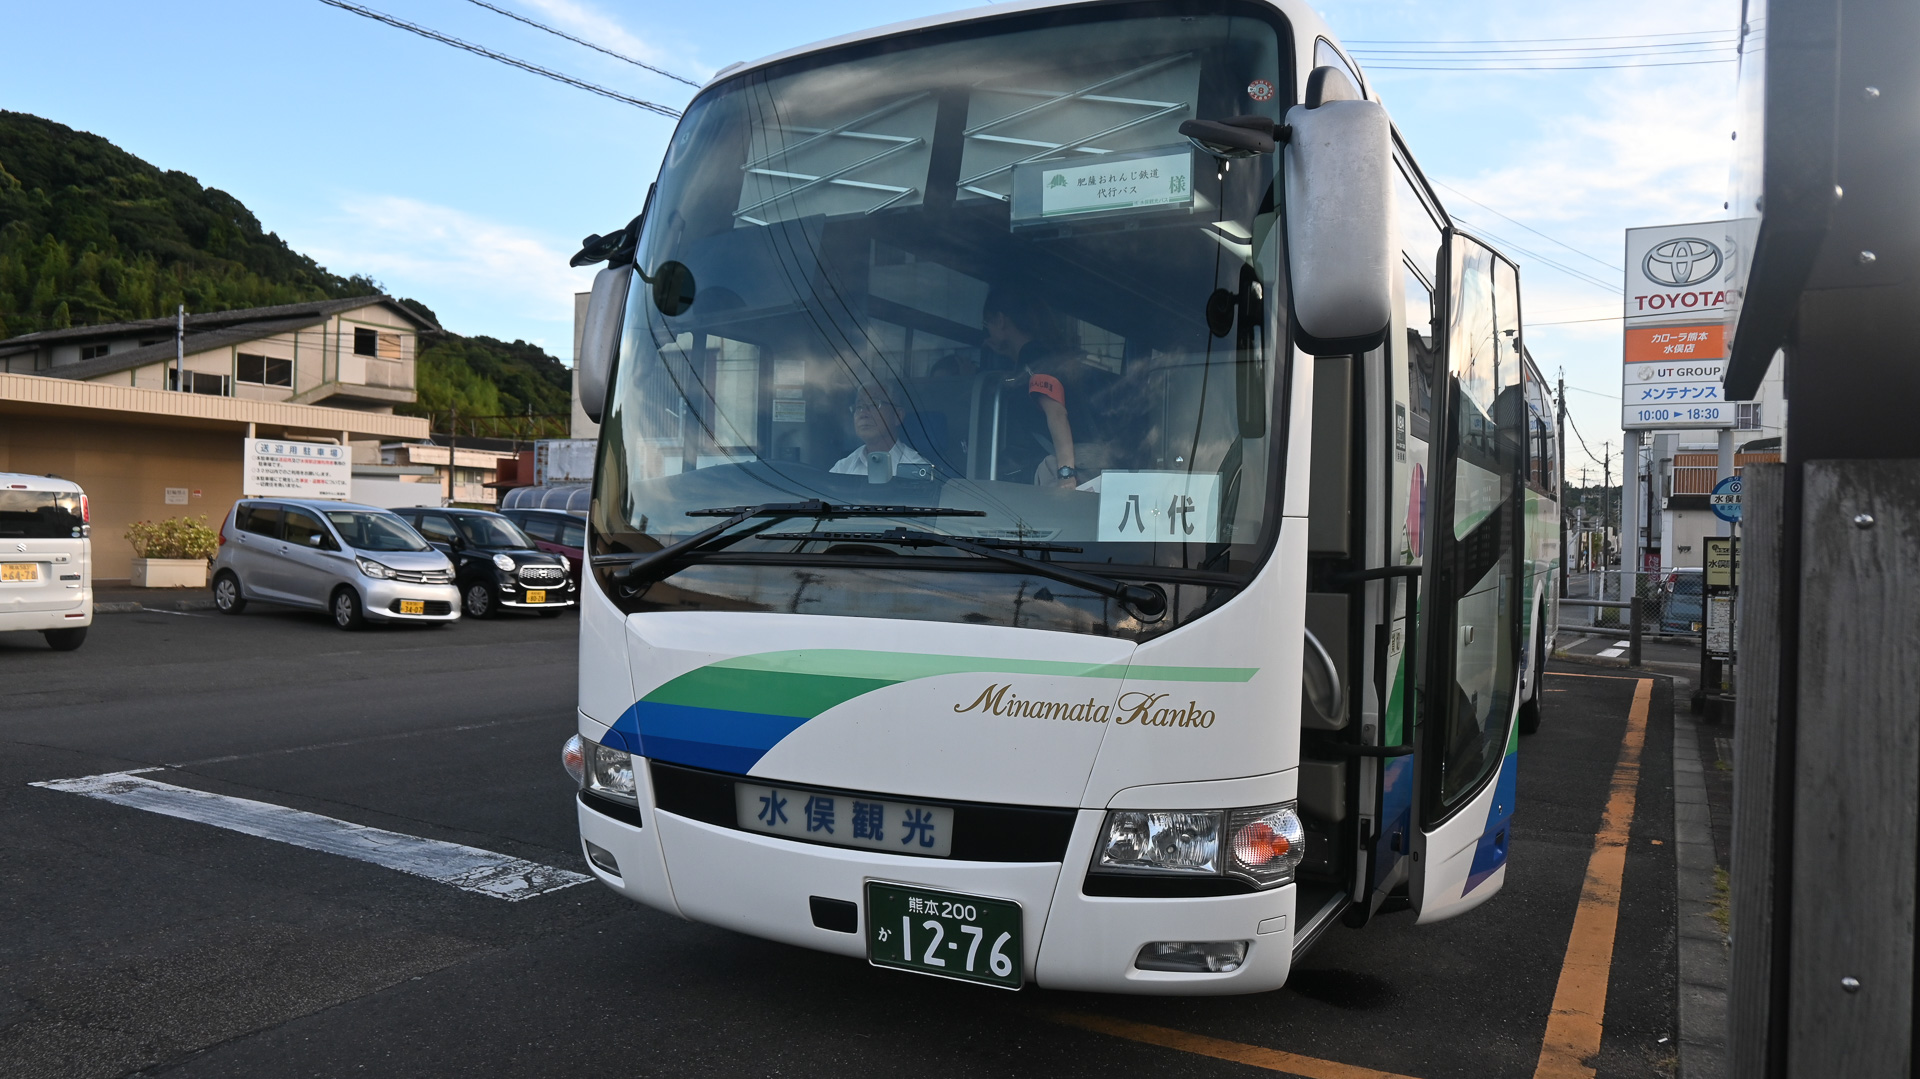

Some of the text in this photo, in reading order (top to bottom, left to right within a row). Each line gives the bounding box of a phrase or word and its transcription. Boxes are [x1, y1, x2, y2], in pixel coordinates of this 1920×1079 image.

[1076, 168, 1160, 187] 肥薩おれんじ鉄道
[1168, 174, 1186, 194] 様
[1097, 186, 1138, 199] 代行バス
[1634, 290, 1725, 311] TOYOTA
[1651, 331, 1709, 344] カローラ熊本
[1663, 343, 1695, 354] 水俣店
[1657, 366, 1721, 378] UT GROUP
[1641, 386, 1718, 401] メンテナンス
[1638, 408, 1720, 421] 10:00 18:30
[260, 443, 338, 457] 送迎用駐車場
[1118, 494, 1196, 536] 八代
[953, 683, 1216, 729] Minamata Kanko
[757, 790, 935, 848] 水俣観光
[878, 926, 892, 941] か
[902, 915, 1013, 978] 12-76
